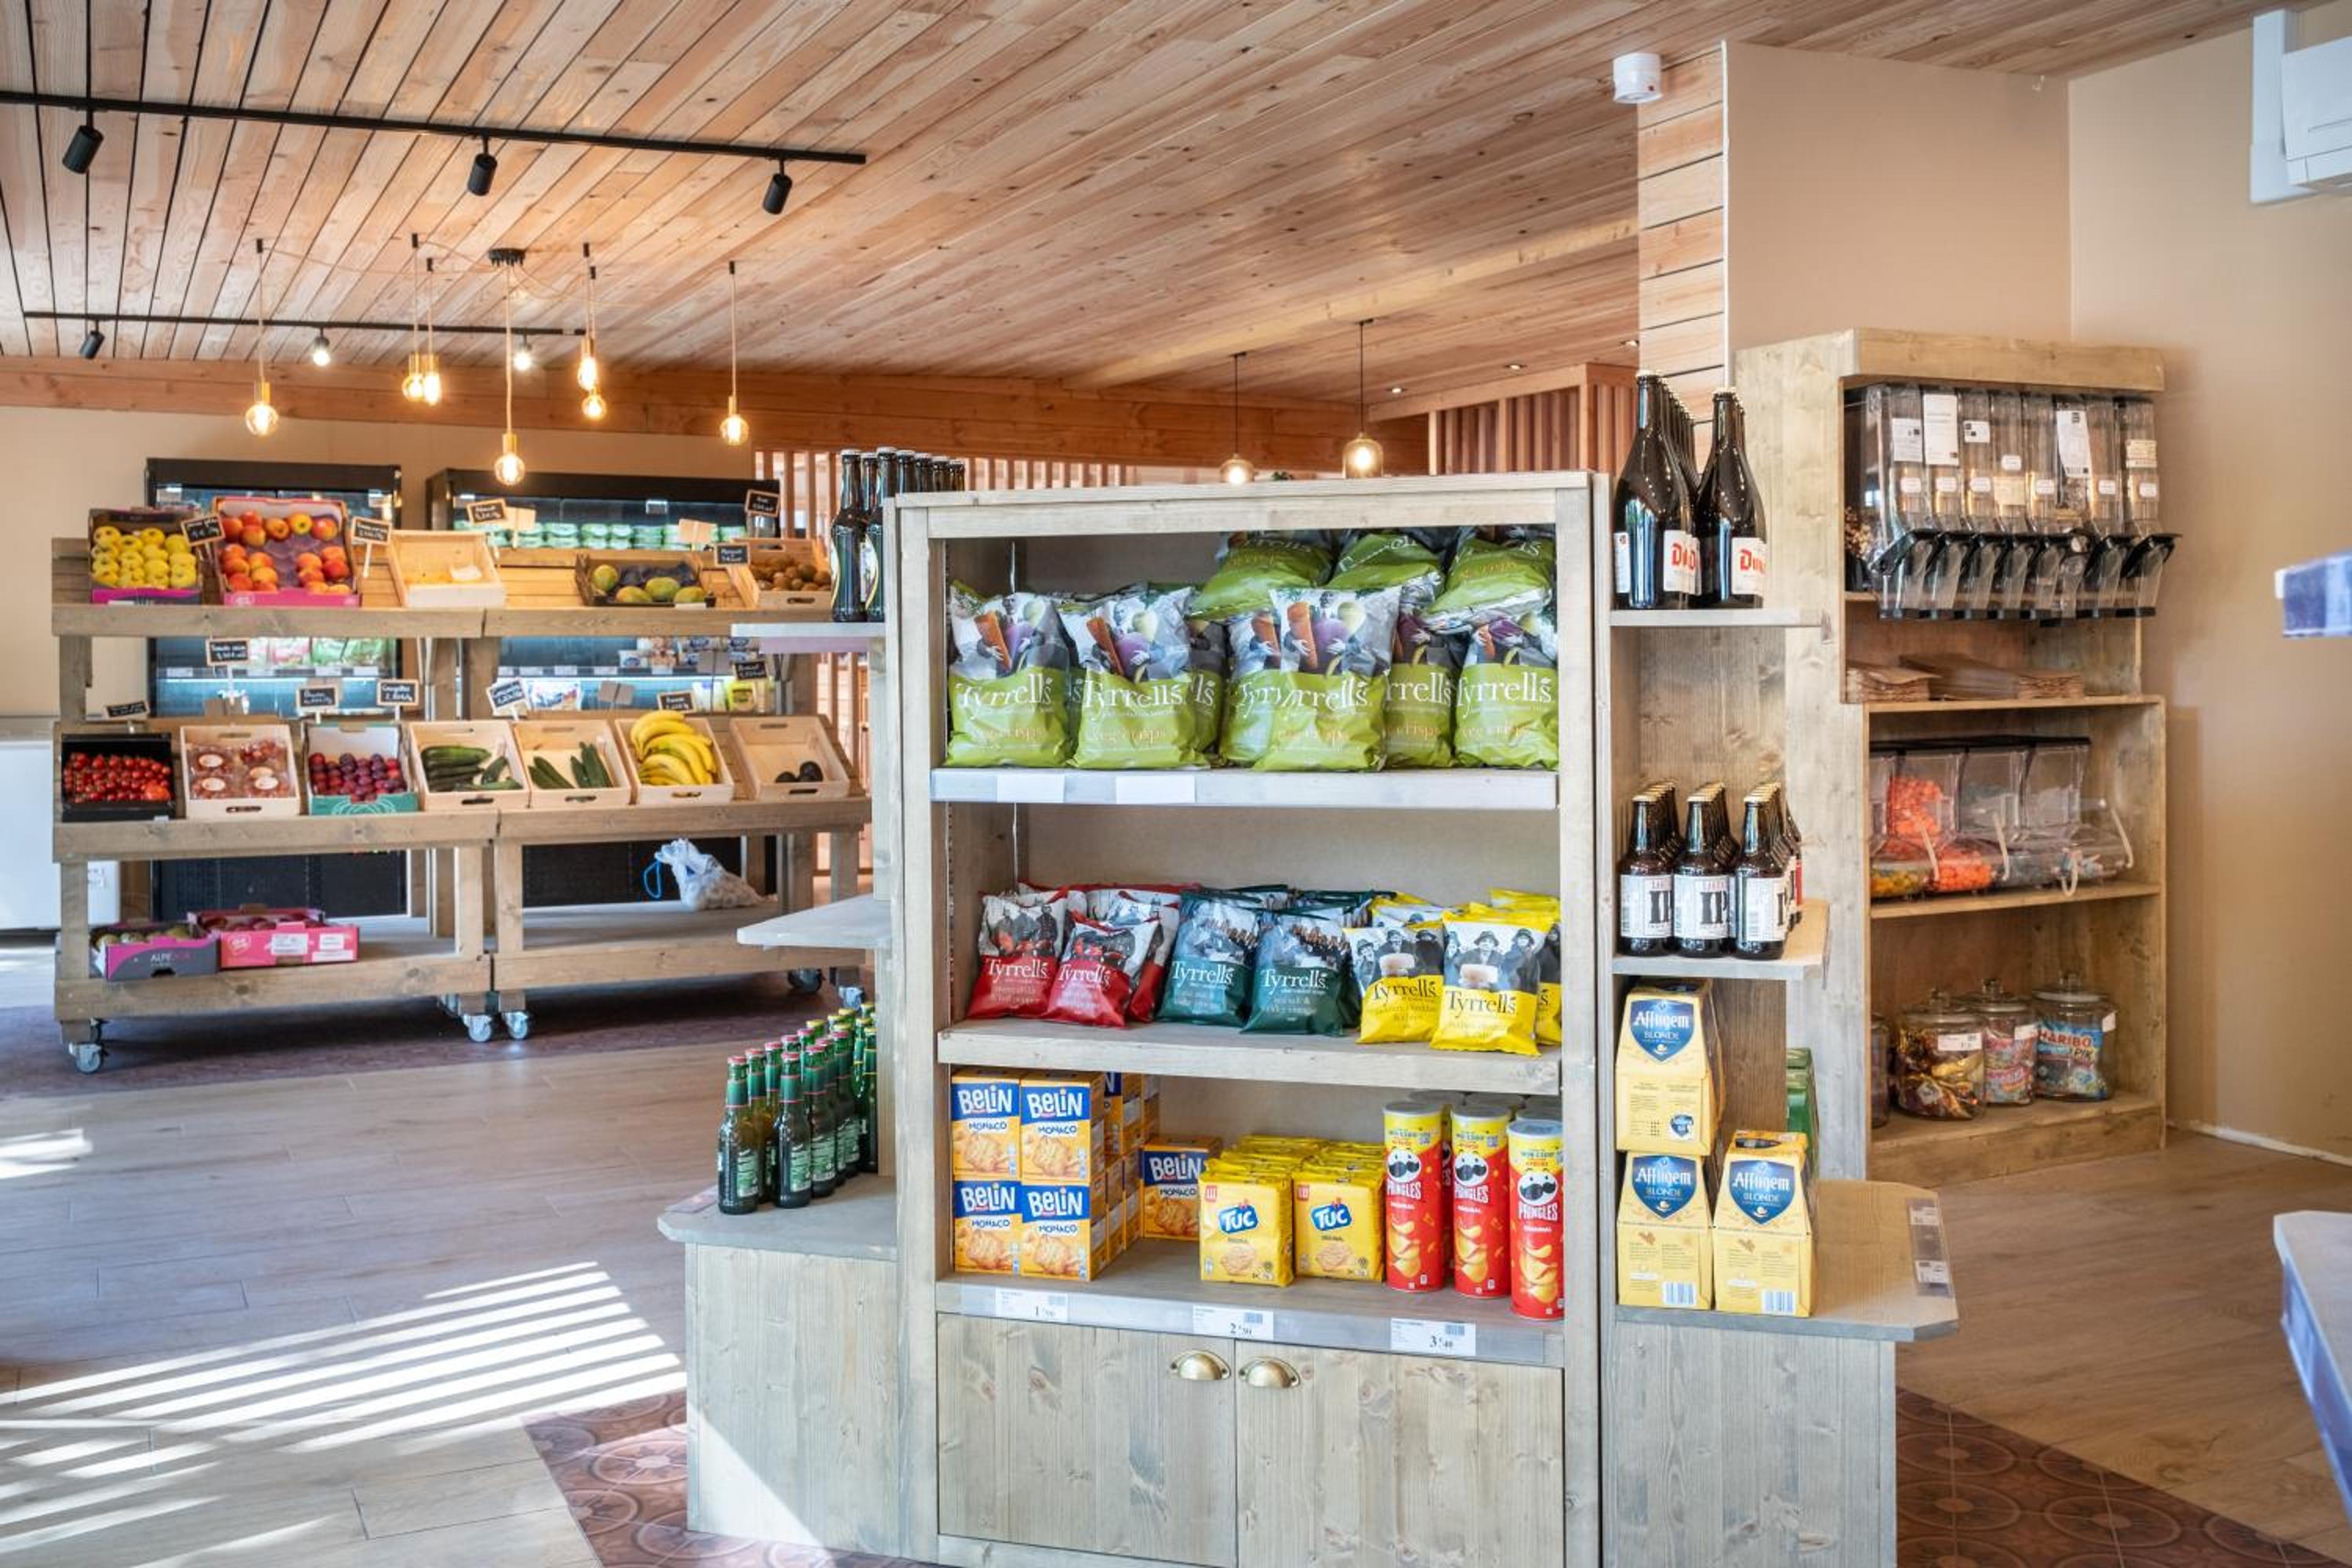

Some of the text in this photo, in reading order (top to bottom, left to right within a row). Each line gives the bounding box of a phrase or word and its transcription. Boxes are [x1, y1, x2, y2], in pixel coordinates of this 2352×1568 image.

[956, 673, 1052, 720] Tyrrells
[1083, 676, 1184, 720] Tyrrells
[1385, 672, 1452, 706] rrells
[986, 959, 1048, 982] Tyrrells
[1058, 964, 1111, 988] Tyrrells
[1173, 960, 1235, 986] Tyrrells
[1261, 969, 1329, 995] Tyrrells
[1372, 978, 1437, 1002] Tyrrells
[1446, 990, 1518, 1018] Tyrrells
[968, 1122, 1007, 1131] MONACO
[1038, 1125, 1076, 1134] MONACO
[1646, 1187, 1681, 1196] BLONDE
[1744, 1192, 1780, 1202] BLONDE
[972, 1219, 1010, 1228] MONACO
[1039, 1225, 1077, 1233] MONACO
